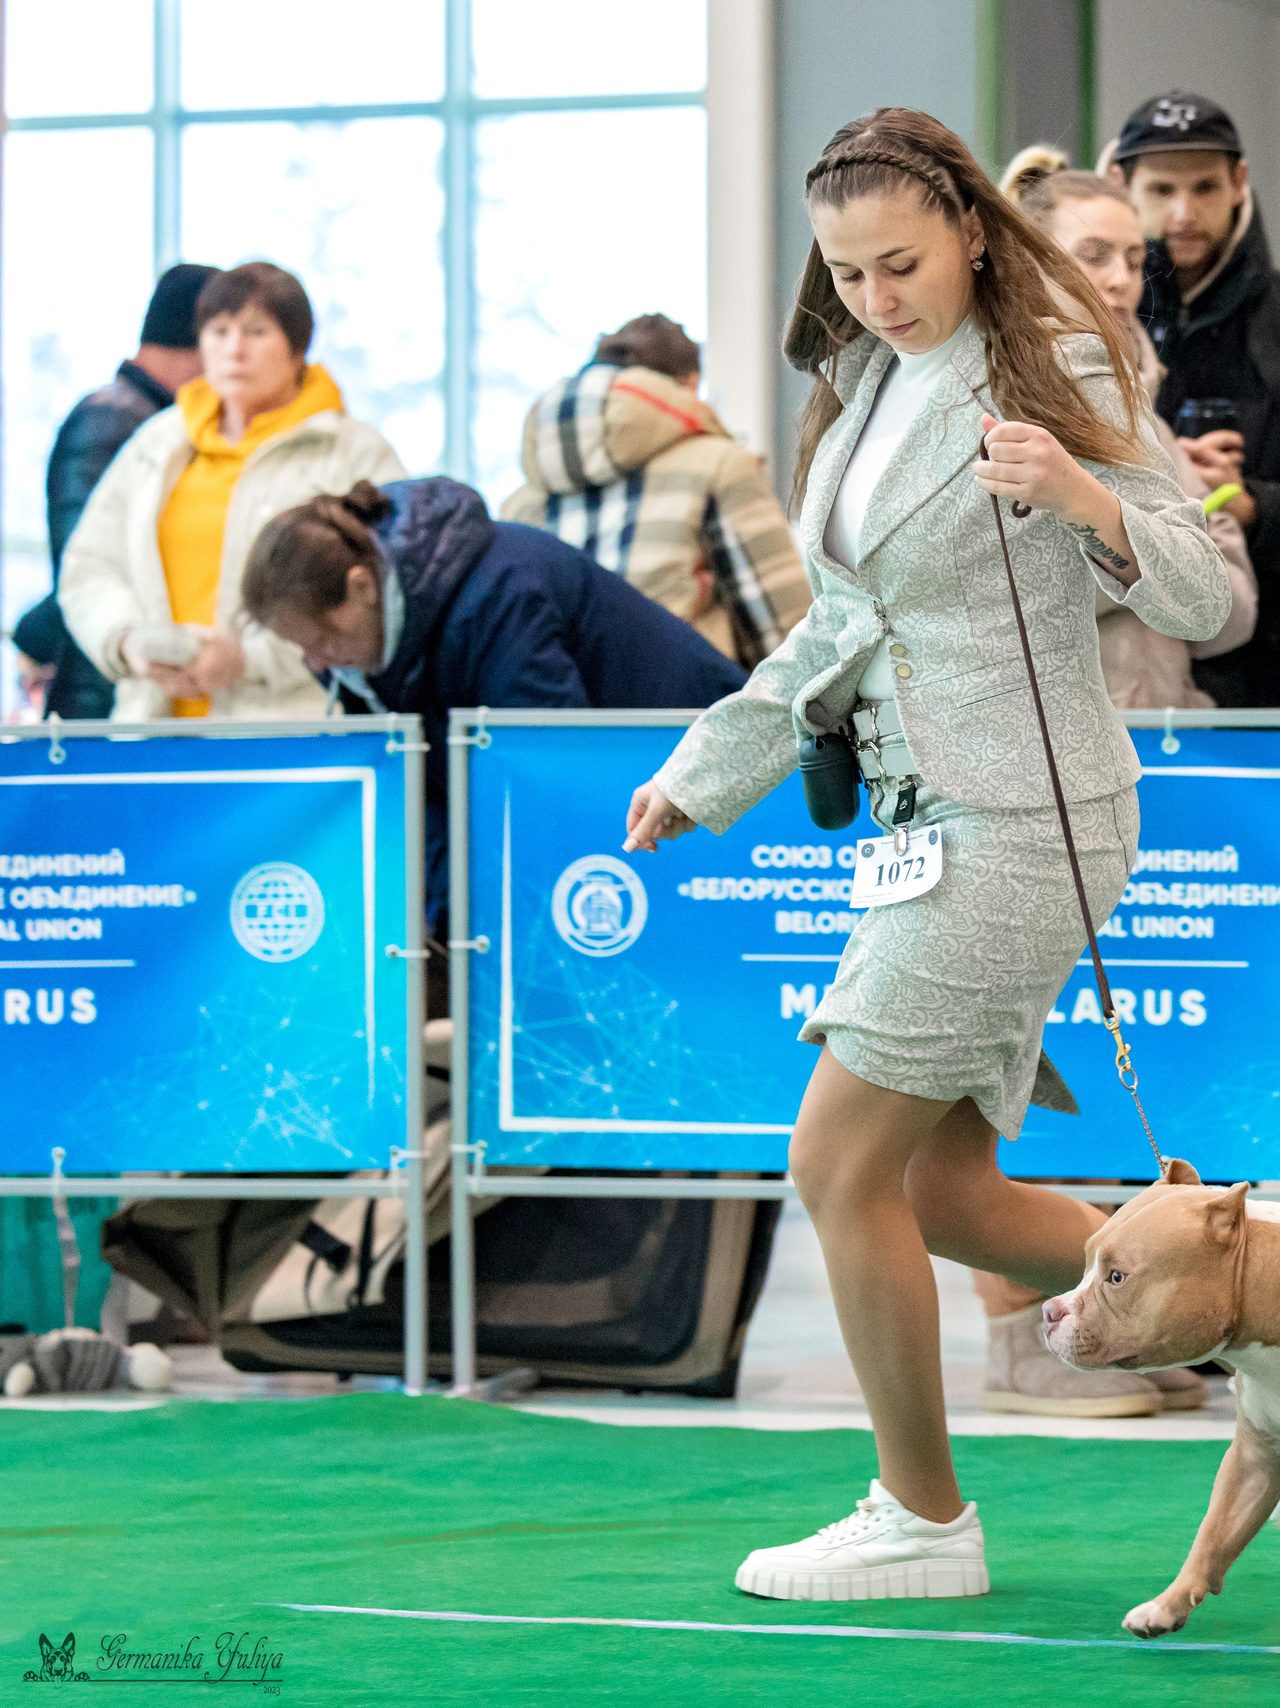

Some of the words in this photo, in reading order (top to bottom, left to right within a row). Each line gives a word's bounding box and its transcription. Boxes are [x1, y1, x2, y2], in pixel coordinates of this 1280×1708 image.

[751, 844, 833, 869] СОЮЗ
[874, 856, 926, 887] 1072
[678, 877, 853, 901] «БЕЛОРУССКО
[25, 917, 102, 941] UNION
[1132, 915, 1215, 938] UNION
